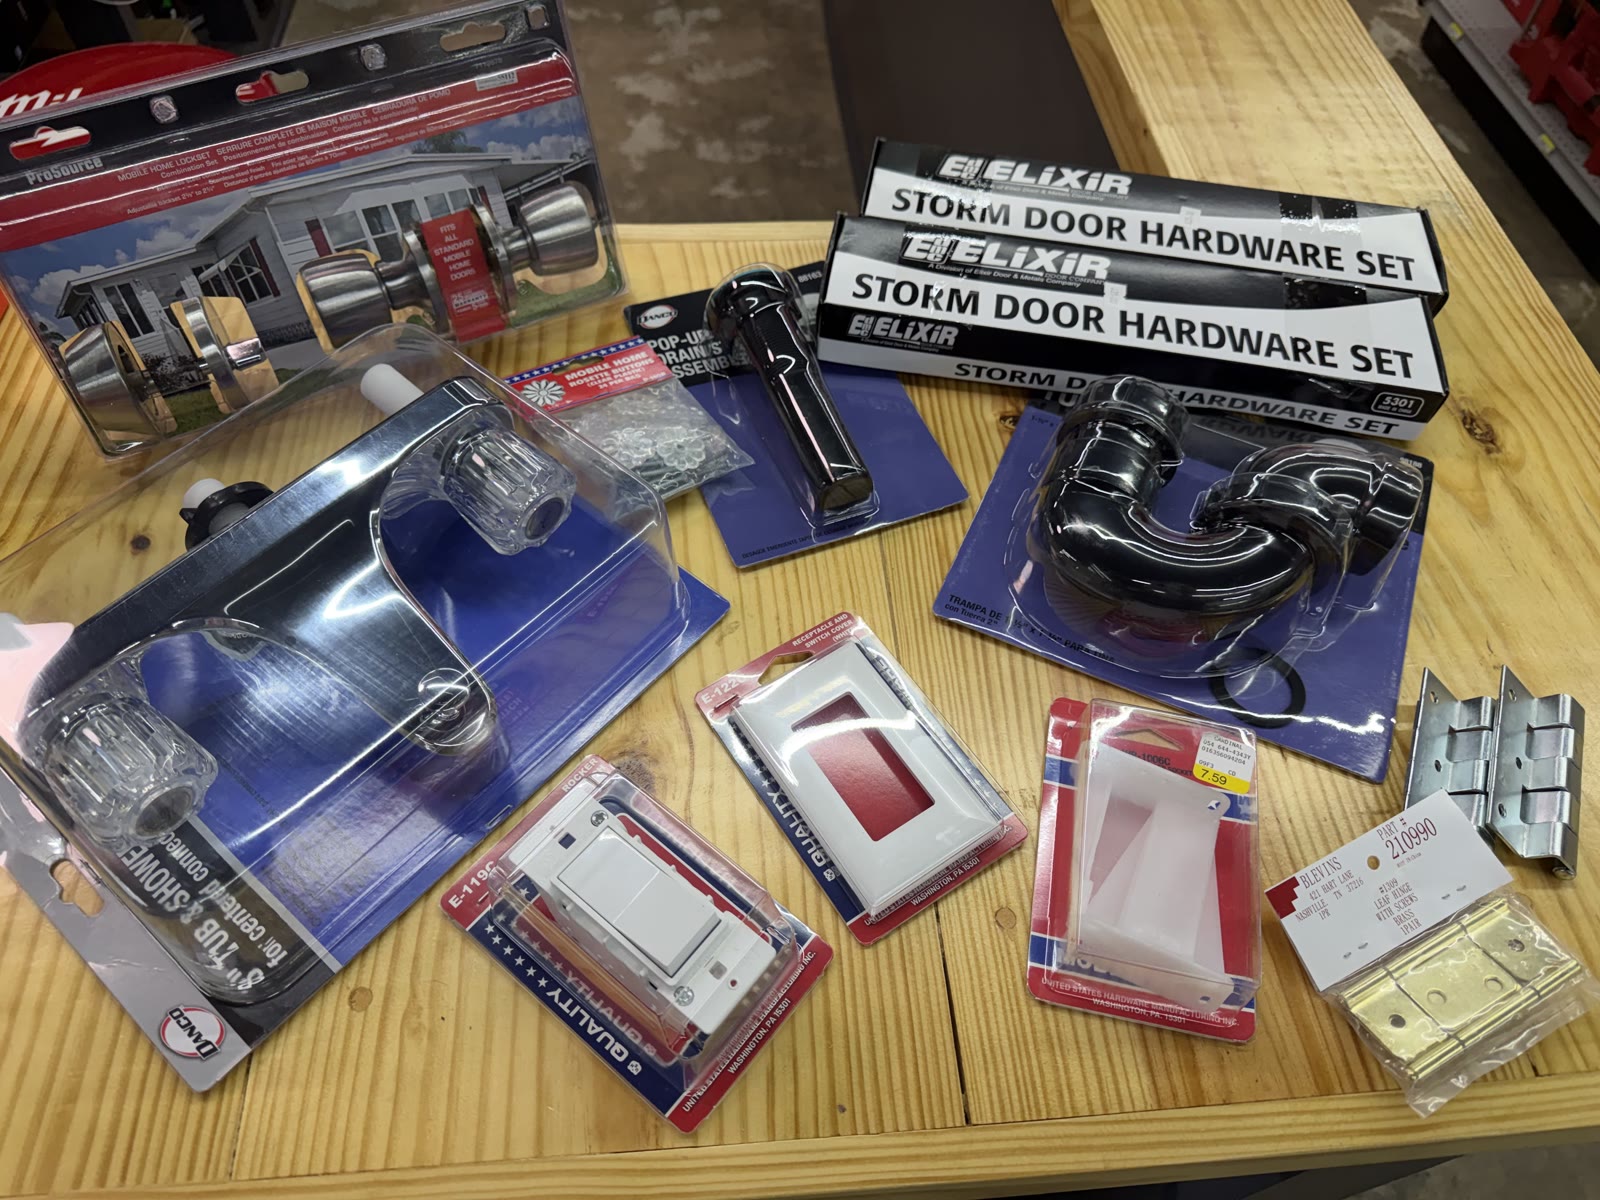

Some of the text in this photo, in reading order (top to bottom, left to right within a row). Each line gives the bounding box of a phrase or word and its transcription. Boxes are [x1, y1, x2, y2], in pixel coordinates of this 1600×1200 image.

[372, 89, 451, 114] CERRADURA DE POMO
[216, 140, 253, 156] SERRURE
[297, 126, 307, 134] DE
[308, 118, 339, 131] MAISON
[339, 110, 367, 124] MOBILE
[223, 143, 276, 162] Positionnement
[277, 142, 286, 150] de
[25, 157, 103, 185] ProSource
[117, 167, 149, 182] MOBILE
[150, 161, 174, 173] HOME
[176, 151, 211, 166] LOCKSET
[160, 159, 218, 179] Combination Set
[440, 223, 456, 234] FITS
[444, 234, 458, 242] ALL
[892, 188, 1415, 281] STORM DOOR HARDWARE SET
[434, 239, 474, 256] STANDARD
[443, 250, 471, 263] MOBILE
[449, 260, 471, 271] HOME
[1046, 277, 1082, 288] Company
[852, 273, 979, 316] STORM
[995, 294, 1105, 333] DOOR
[1119, 310, 1338, 369] HARDWARE
[1351, 344, 1413, 379] SET
[565, 352, 648, 381] MOBILE HOME
[569, 358, 655, 387] ROSETTE BUTTONS
[955, 363, 1055, 386] STORM
[587, 376, 613, 388] (CLEAR
[1169, 389, 1400, 435] HARDWARE SET
[1382, 396, 1414, 408] 5301
[944, 603, 958, 613] con
[961, 607, 986, 623] Tuerca
[949, 595, 986, 614] TRAMPA
[988, 610, 1003, 620] DE
[792, 613, 848, 647] RECEPTACLE AND
[804, 620, 853, 648] SWITCH COVER
[1214, 735, 1243, 750] CARDINAL
[562, 758, 598, 793] ROCKER
[1201, 768, 1227, 785] 7.59
[767, 792, 826, 867] QUALITY
[1376, 817, 1407, 840] PART #
[1385, 818, 1437, 859] 210990
[117, 846, 190, 912] SHOWE
[911, 856, 980, 906] WASHINGTON, PA 15301
[1300, 857, 1342, 889] BLEVINS
[1309, 870, 1354, 901] 421 HART LANE
[1379, 878, 1399, 894] #1309
[1333, 891, 1343, 900] TN
[1346, 877, 1364, 892] 37216
[1373, 882, 1413, 910] LEAF HINGE
[180, 901, 204, 924] &
[1376, 893, 1419, 922] WITH SCREWS
[1393, 909, 1415, 926] BRASS
[1400, 918, 1422, 936] 1PAIR
[1041, 977, 1240, 1026] UNITED STATES HARDWARE MANUFACTURING INC.
[1092, 998, 1186, 1024] WASHINGTON, PA. 15301
[169, 1008, 218, 1058] DANCO
[546, 988, 629, 1062] QUALITY
[682, 1083, 708, 1113] UNITED
[802, 949, 817, 966] INC.
[727, 997, 792, 1075] WASHINGTON, PA 15301
